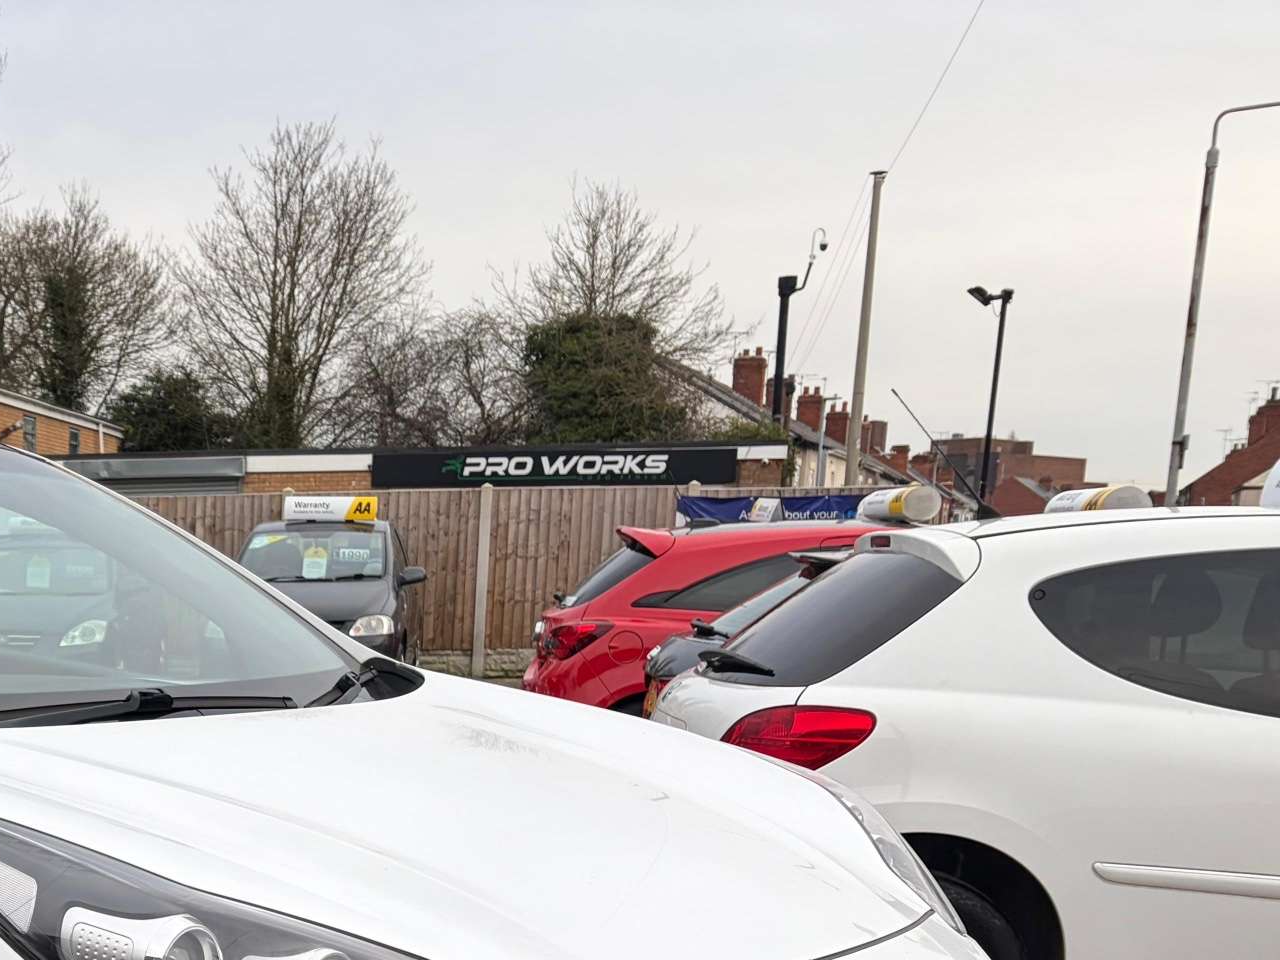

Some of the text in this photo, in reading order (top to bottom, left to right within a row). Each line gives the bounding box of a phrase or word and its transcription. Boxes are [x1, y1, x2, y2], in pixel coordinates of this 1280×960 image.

[463, 454, 669, 476] PRO WORKS
[294, 501, 330, 510] Warranty
[353, 501, 372, 514] AA
